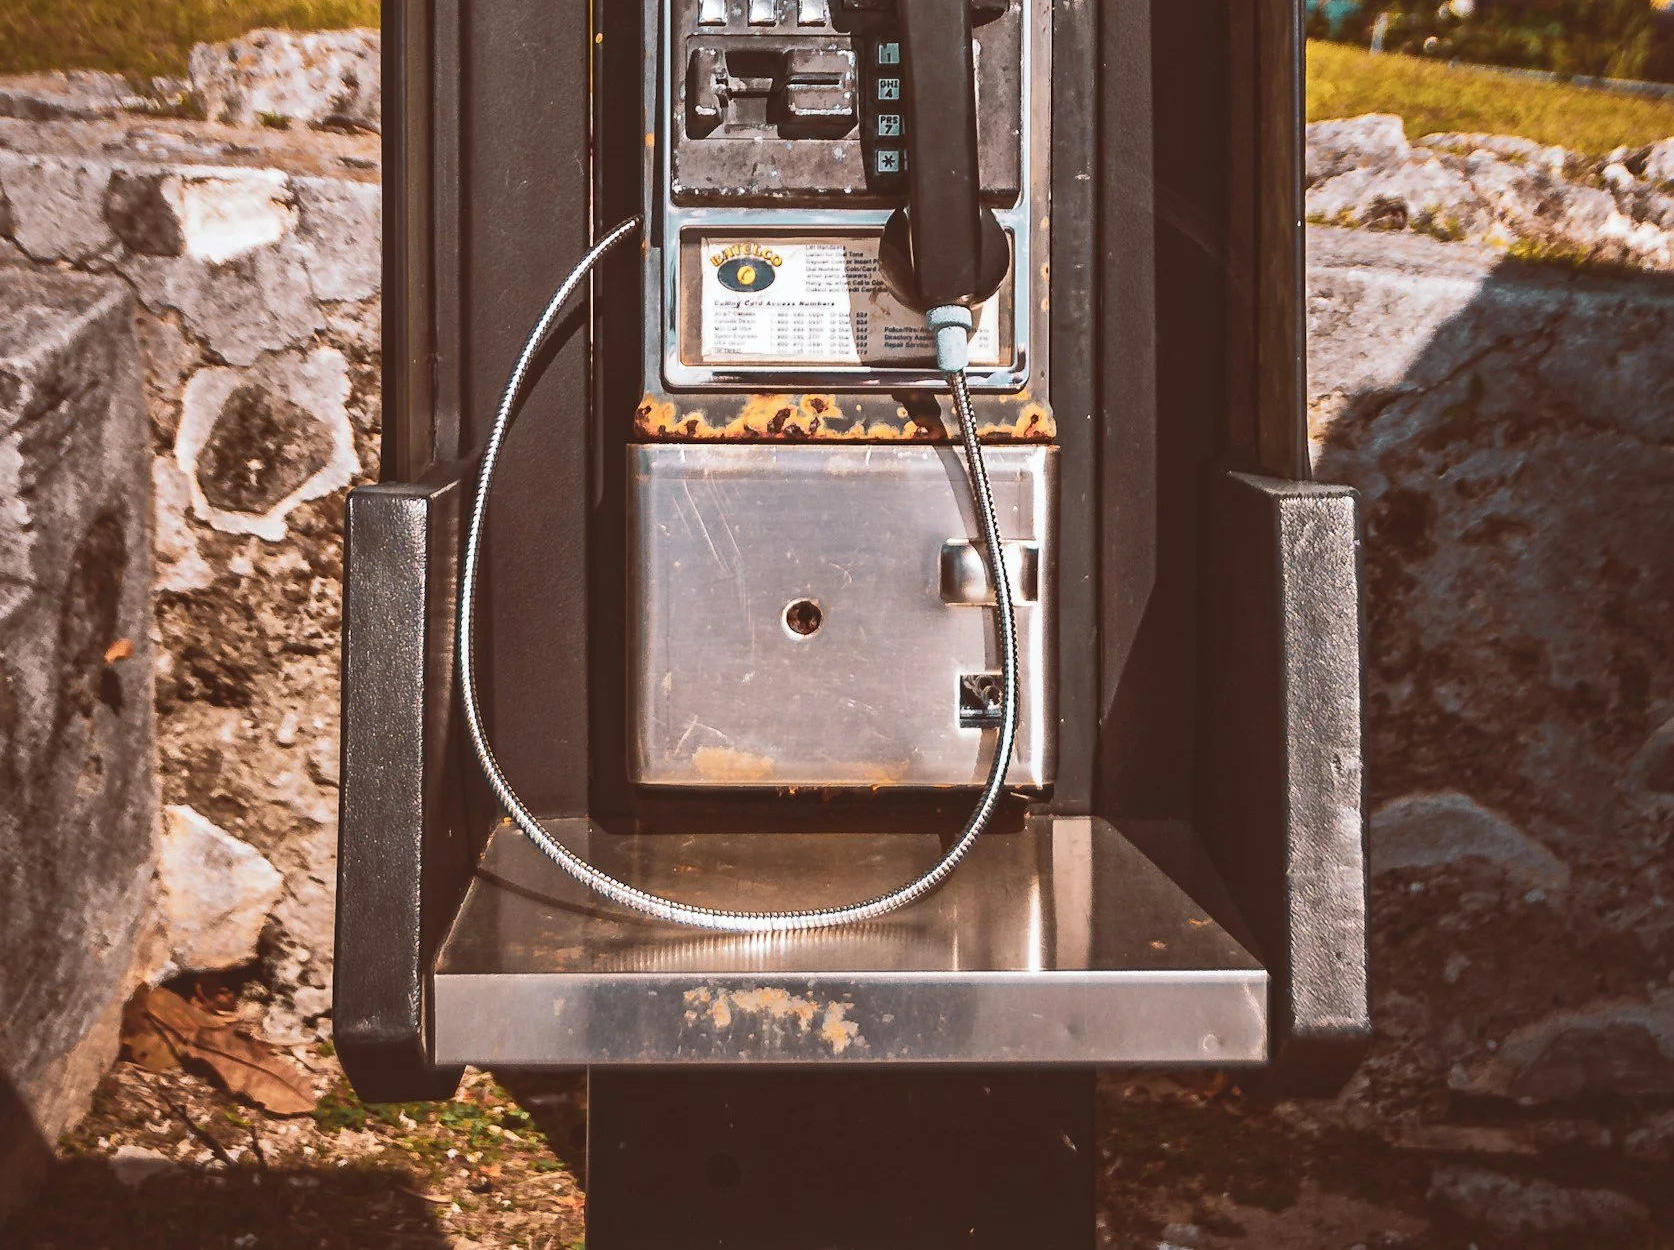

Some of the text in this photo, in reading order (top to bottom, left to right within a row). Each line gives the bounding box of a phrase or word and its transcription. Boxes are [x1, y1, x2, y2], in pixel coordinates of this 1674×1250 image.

[880, 80, 898, 89] GHI
[884, 89, 893, 98] 4
[880, 116, 898, 125] PRS
[884, 124, 892, 134] 7
[714, 300, 741, 309] Calling
[744, 299, 763, 307] Card
